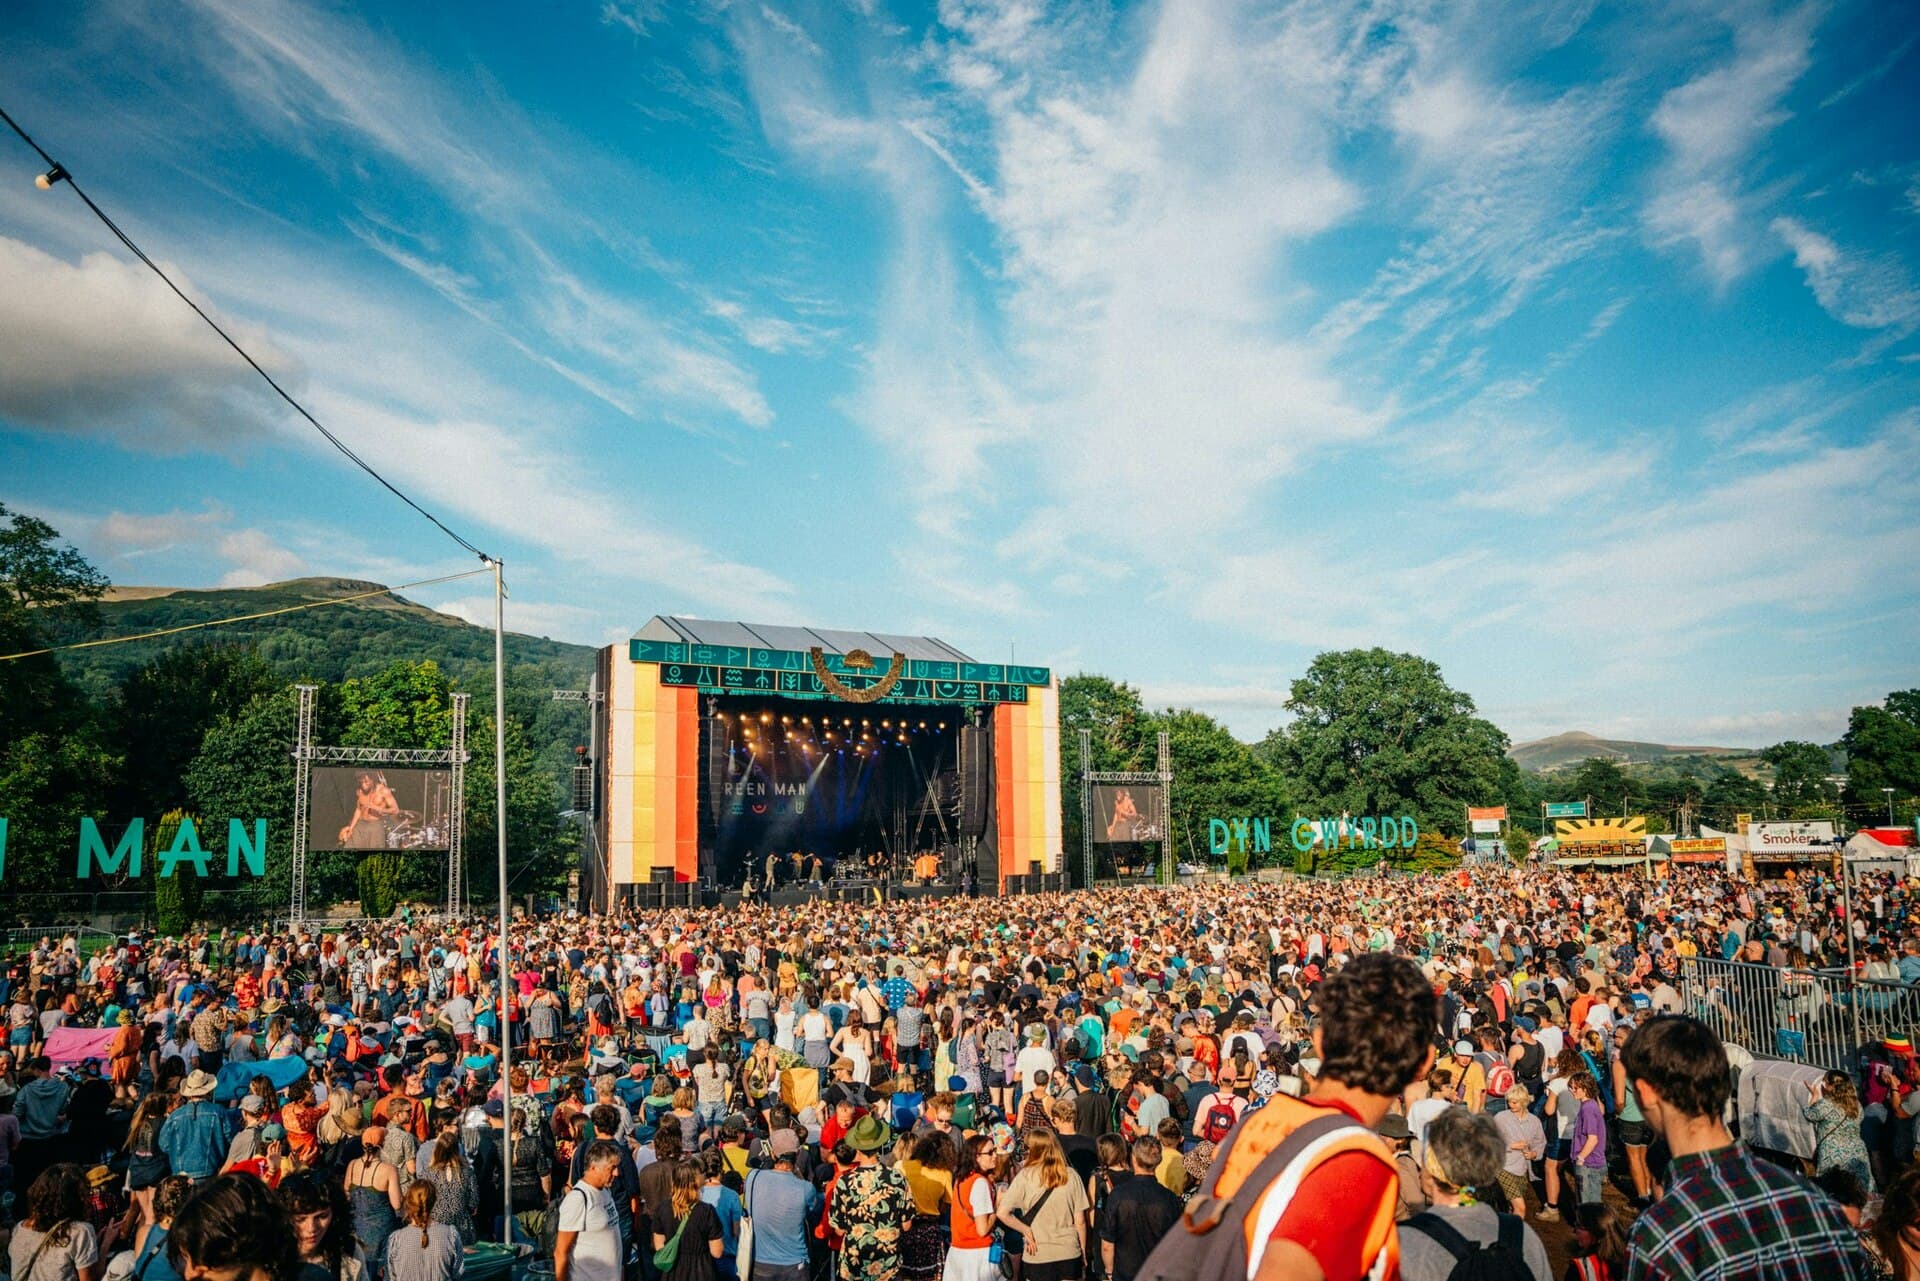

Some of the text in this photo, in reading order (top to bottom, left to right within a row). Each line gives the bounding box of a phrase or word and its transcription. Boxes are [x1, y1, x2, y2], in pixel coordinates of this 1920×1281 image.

[724, 782, 806, 796] REEN MAN
[77, 817, 267, 879] MAN
[1209, 816, 1418, 854] DYN GWYRDD
